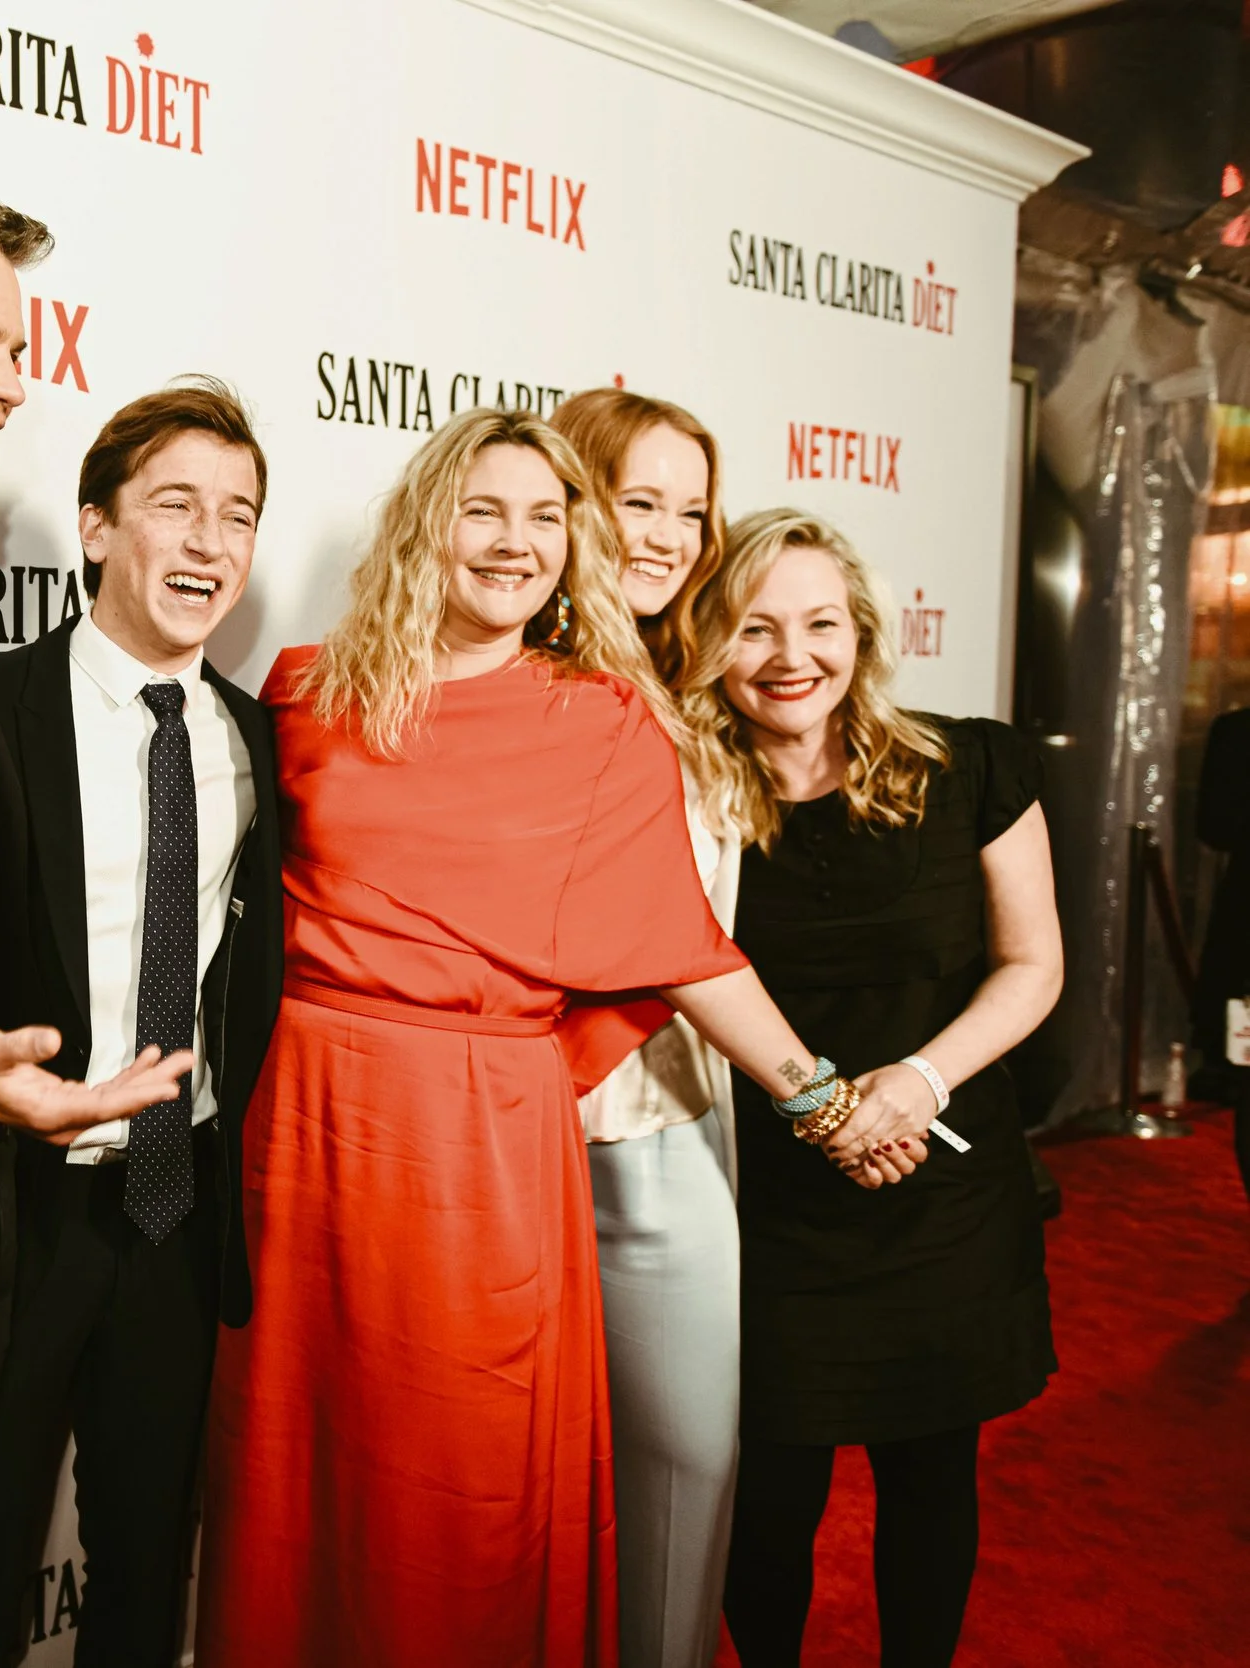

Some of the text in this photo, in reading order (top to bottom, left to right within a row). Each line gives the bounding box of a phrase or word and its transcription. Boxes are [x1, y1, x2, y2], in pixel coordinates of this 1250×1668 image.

[416, 137, 586, 252] NETFLIX
[728, 229, 808, 301] SANTA
[815, 251, 906, 324] CLARITA
[14, 296, 90, 394] IX
[317, 351, 435, 432] SANTA
[788, 421, 901, 493] NETFLIX
